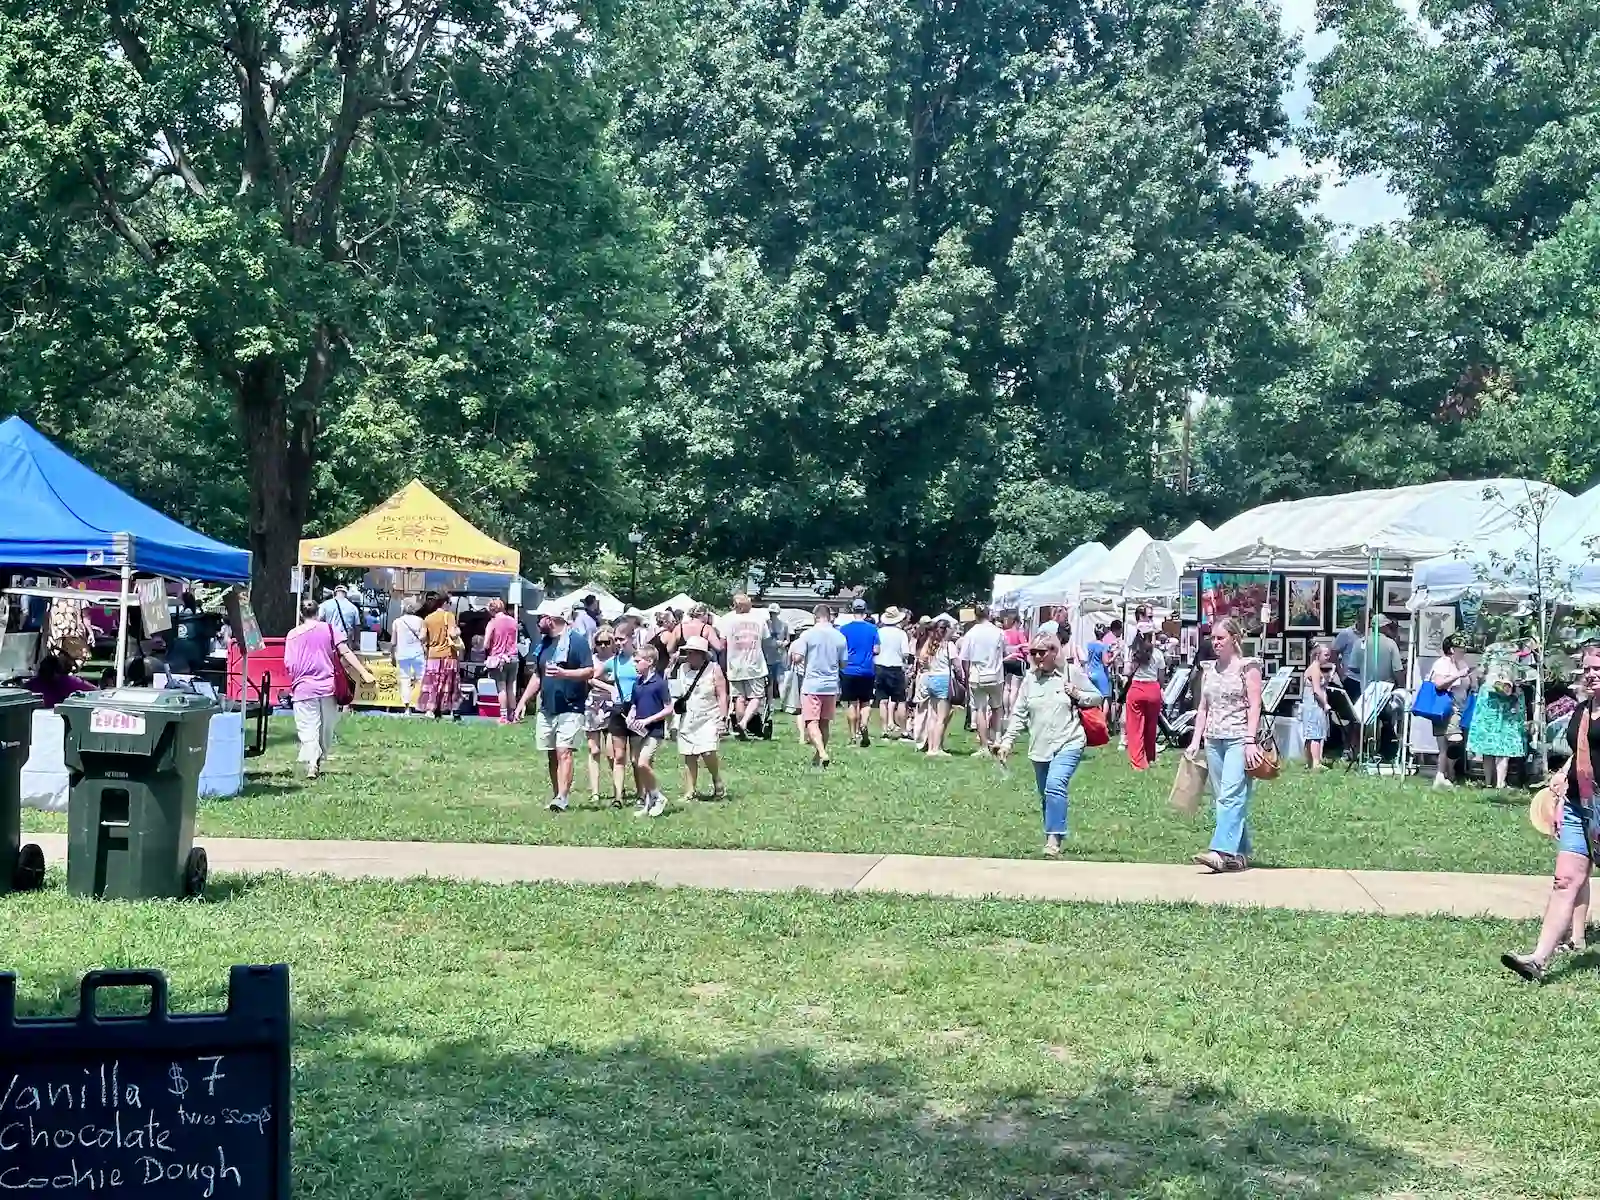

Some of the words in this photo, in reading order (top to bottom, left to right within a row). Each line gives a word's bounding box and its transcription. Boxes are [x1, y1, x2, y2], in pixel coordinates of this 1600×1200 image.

[0, 1109, 175, 1152] Chocolate
[178, 1104, 216, 1126] two
[221, 1104, 273, 1135] scoops
[0, 1159, 124, 1190] Cookie
[135, 1145, 241, 1198] Dough
